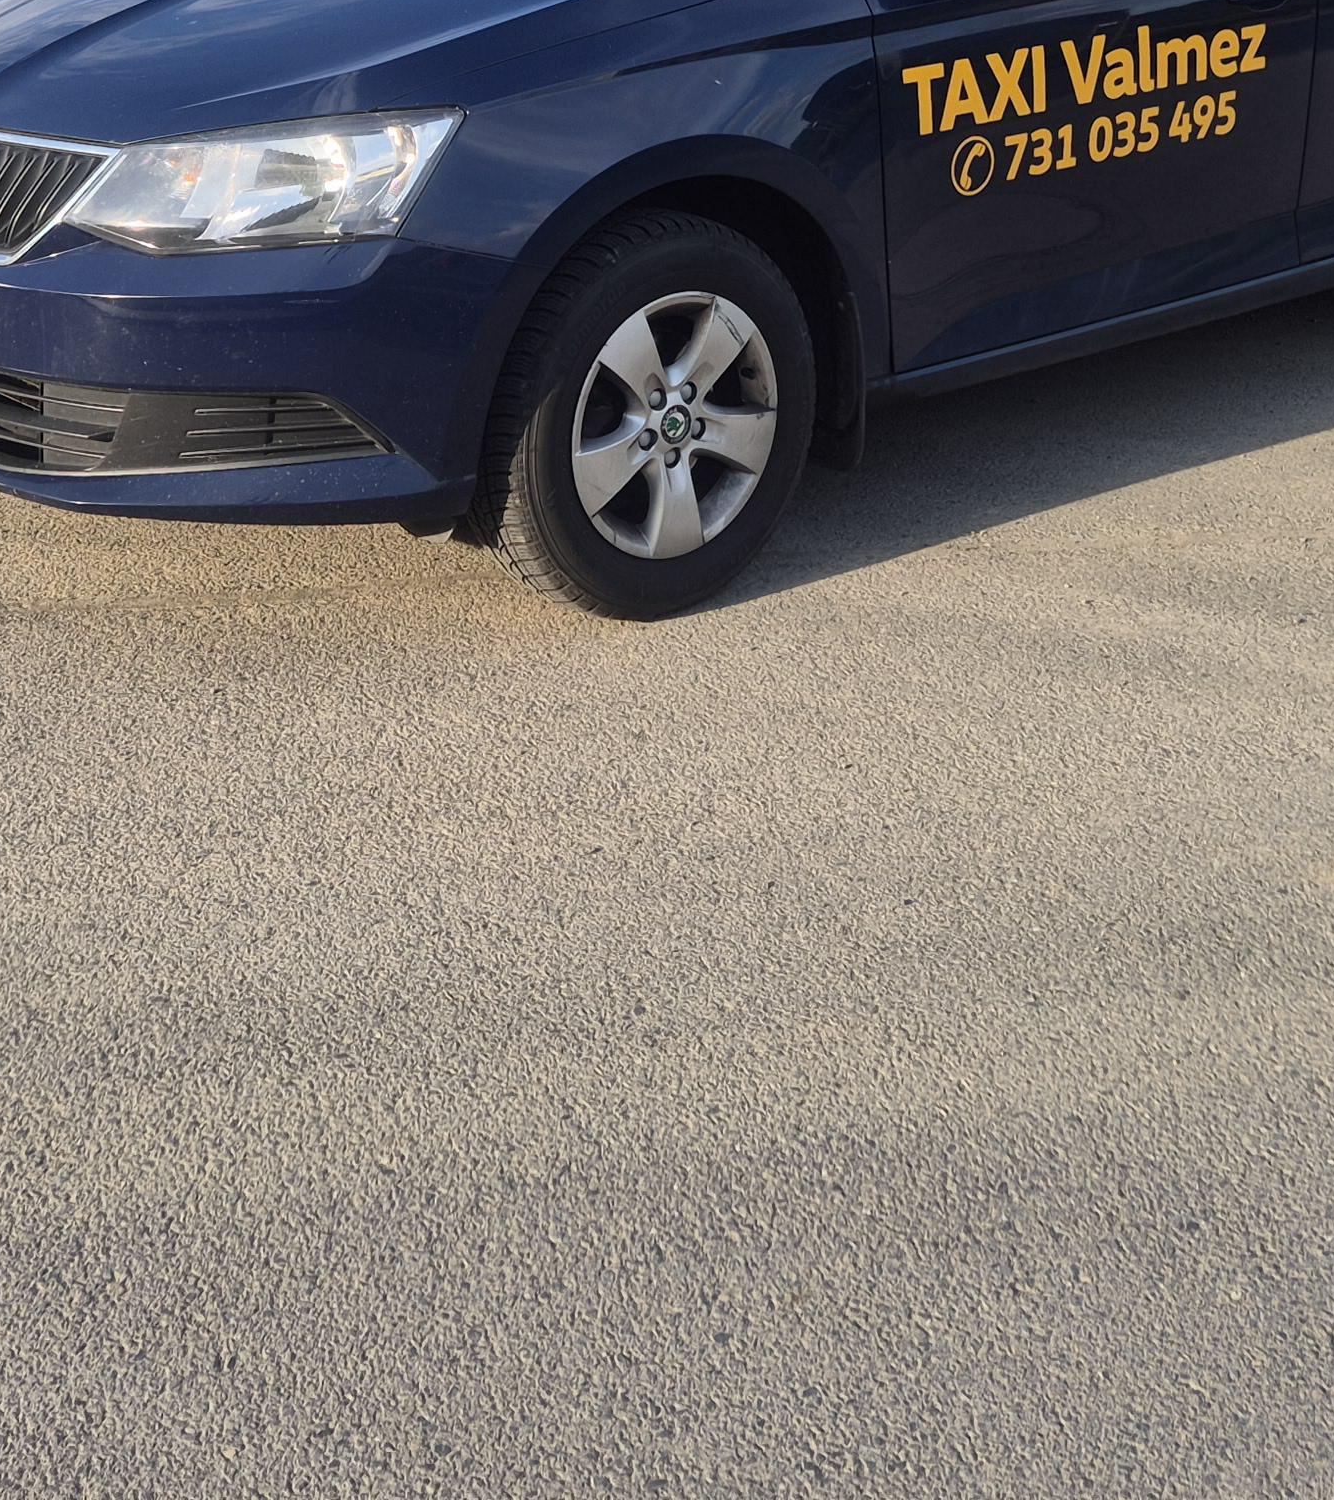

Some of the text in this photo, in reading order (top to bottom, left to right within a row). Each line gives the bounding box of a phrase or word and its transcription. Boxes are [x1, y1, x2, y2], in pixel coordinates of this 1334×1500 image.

[901, 23, 1267, 136] TAXI Valmez
[1004, 90, 1238, 181] 731 035 495
